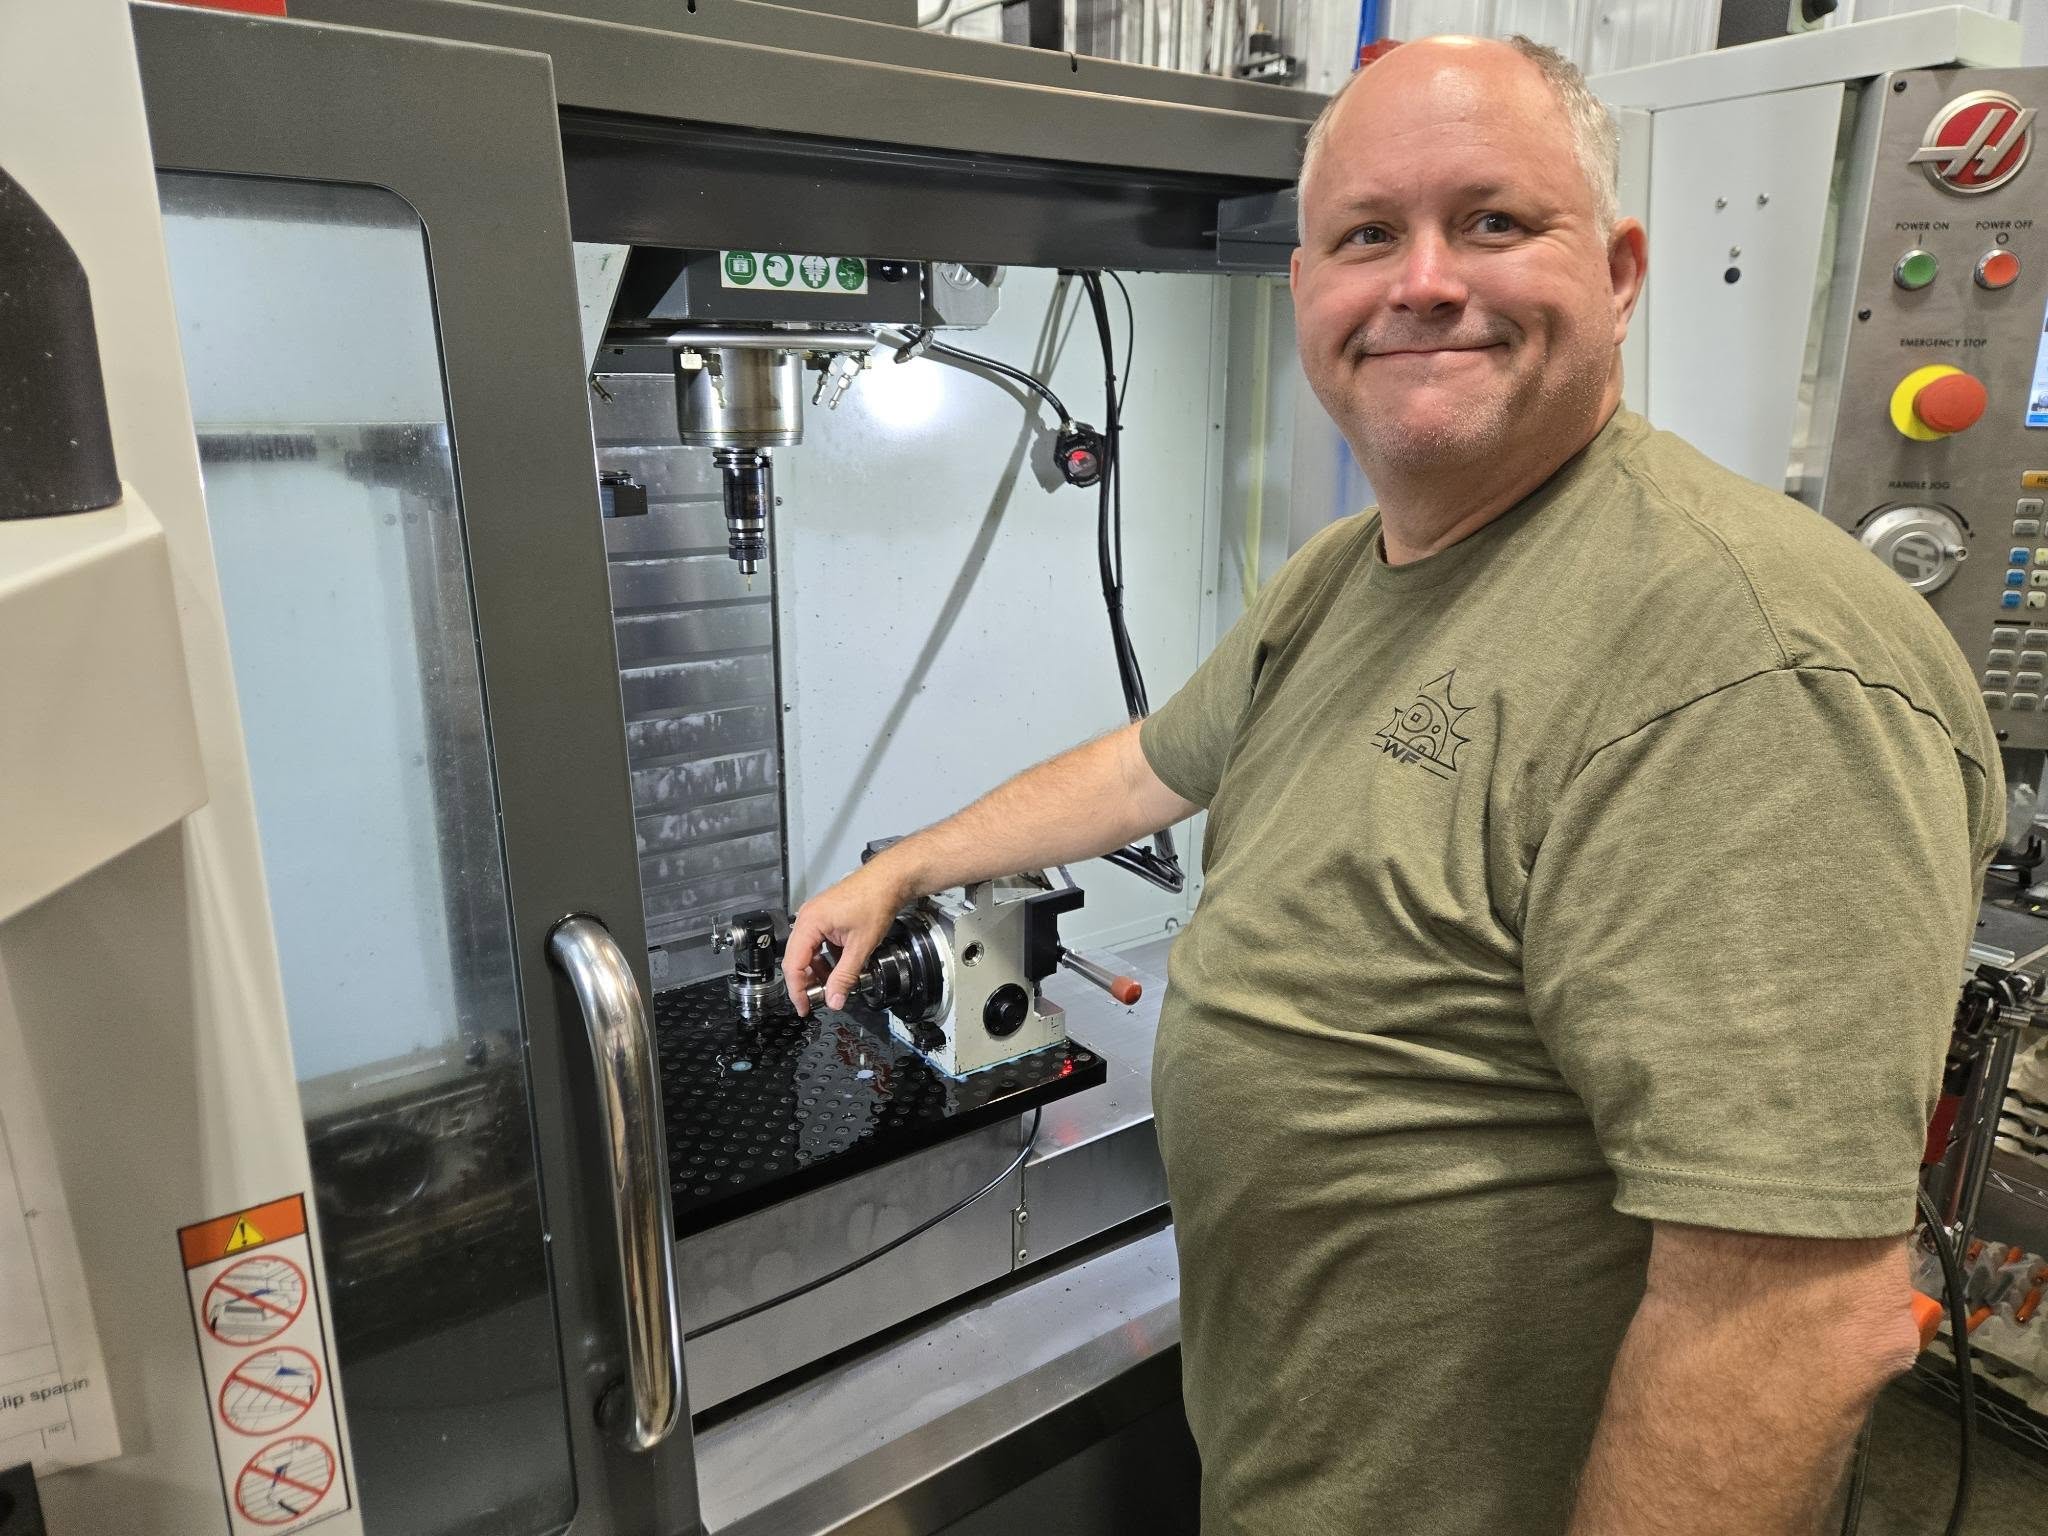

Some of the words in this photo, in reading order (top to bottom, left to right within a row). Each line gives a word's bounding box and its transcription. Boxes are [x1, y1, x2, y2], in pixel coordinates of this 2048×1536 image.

[1895, 221, 1930, 231] POWER
[1933, 220, 1950, 230] ON
[1976, 220, 2011, 230] POWER
[2014, 219, 2034, 230] OFF
[1900, 338, 1961, 347] EMERGENCY
[1962, 338, 1988, 348] STOP
[1888, 480, 1926, 490] HANDLE
[1929, 480, 1951, 490] JOG
